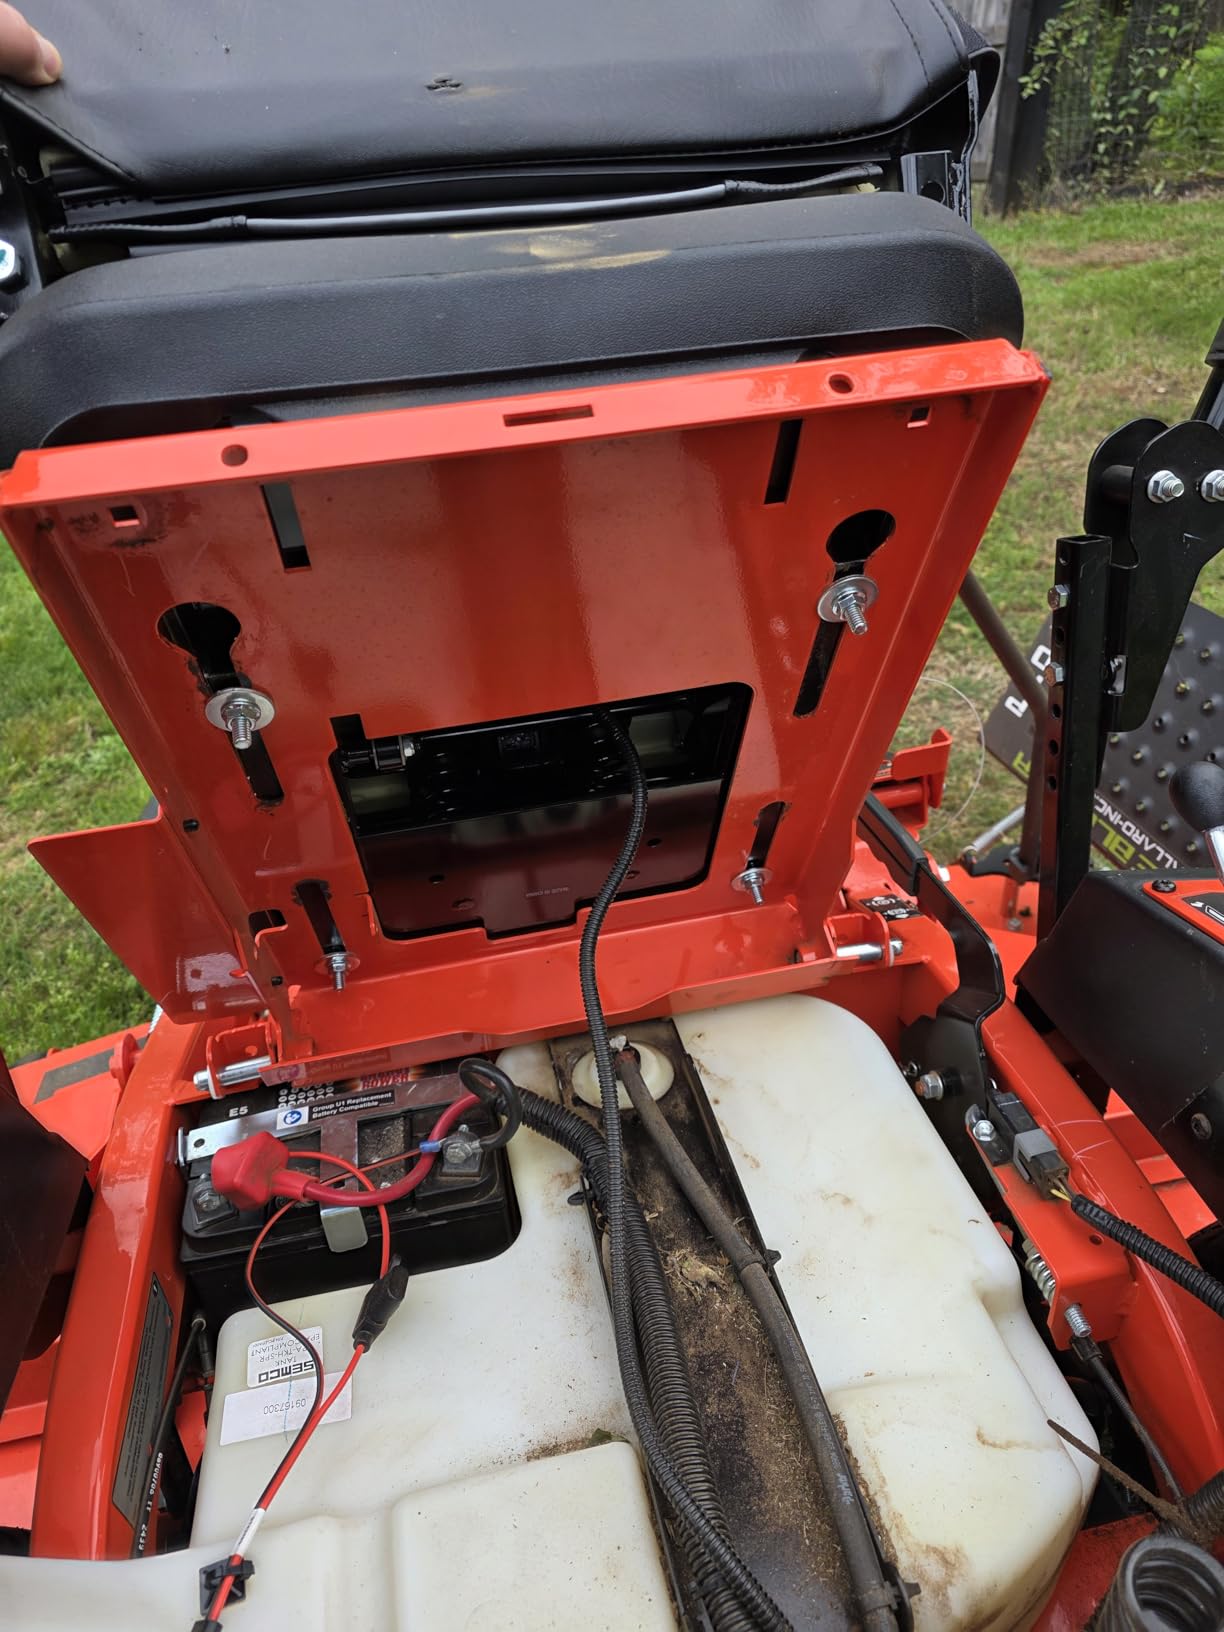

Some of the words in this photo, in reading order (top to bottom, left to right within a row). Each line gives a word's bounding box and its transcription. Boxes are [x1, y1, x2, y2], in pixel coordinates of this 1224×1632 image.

[312, 1103, 335, 1113] Group
[346, 1092, 392, 1105] Replacement
[312, 1108, 338, 1119] Battery
[339, 1100, 379, 1112] Compatible
[274, 1356, 297, 1367] TANK
[258, 1359, 315, 1384] SEMCO
[263, 1397, 307, 1415] 09167300
